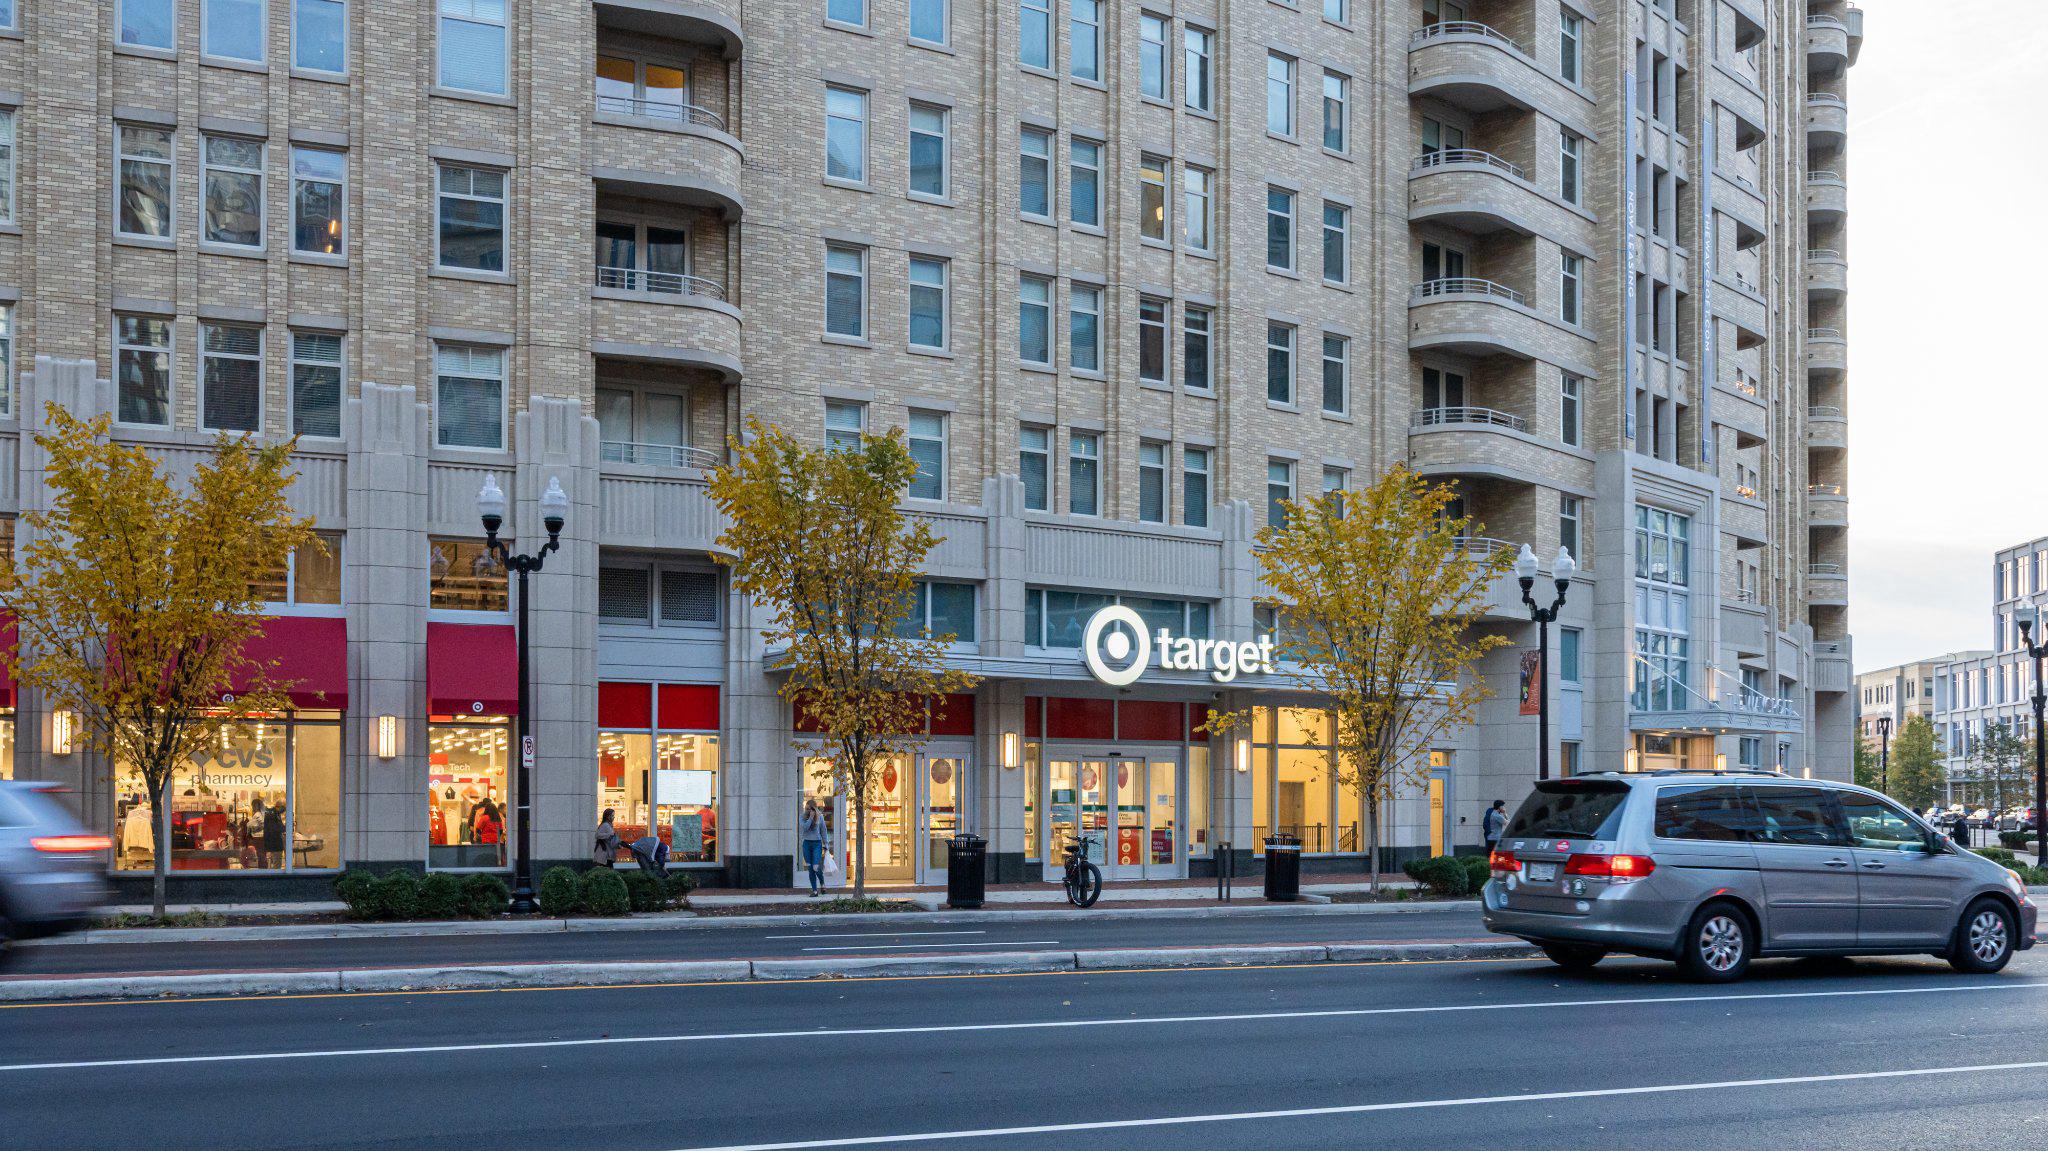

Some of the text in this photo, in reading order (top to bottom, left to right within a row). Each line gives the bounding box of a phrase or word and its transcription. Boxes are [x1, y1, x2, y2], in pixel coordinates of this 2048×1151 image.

[1155, 628, 1275, 683] target
[216, 747, 274, 769] CVS
[449, 763, 471, 772] Tech
[191, 769, 273, 787] pharmacy
